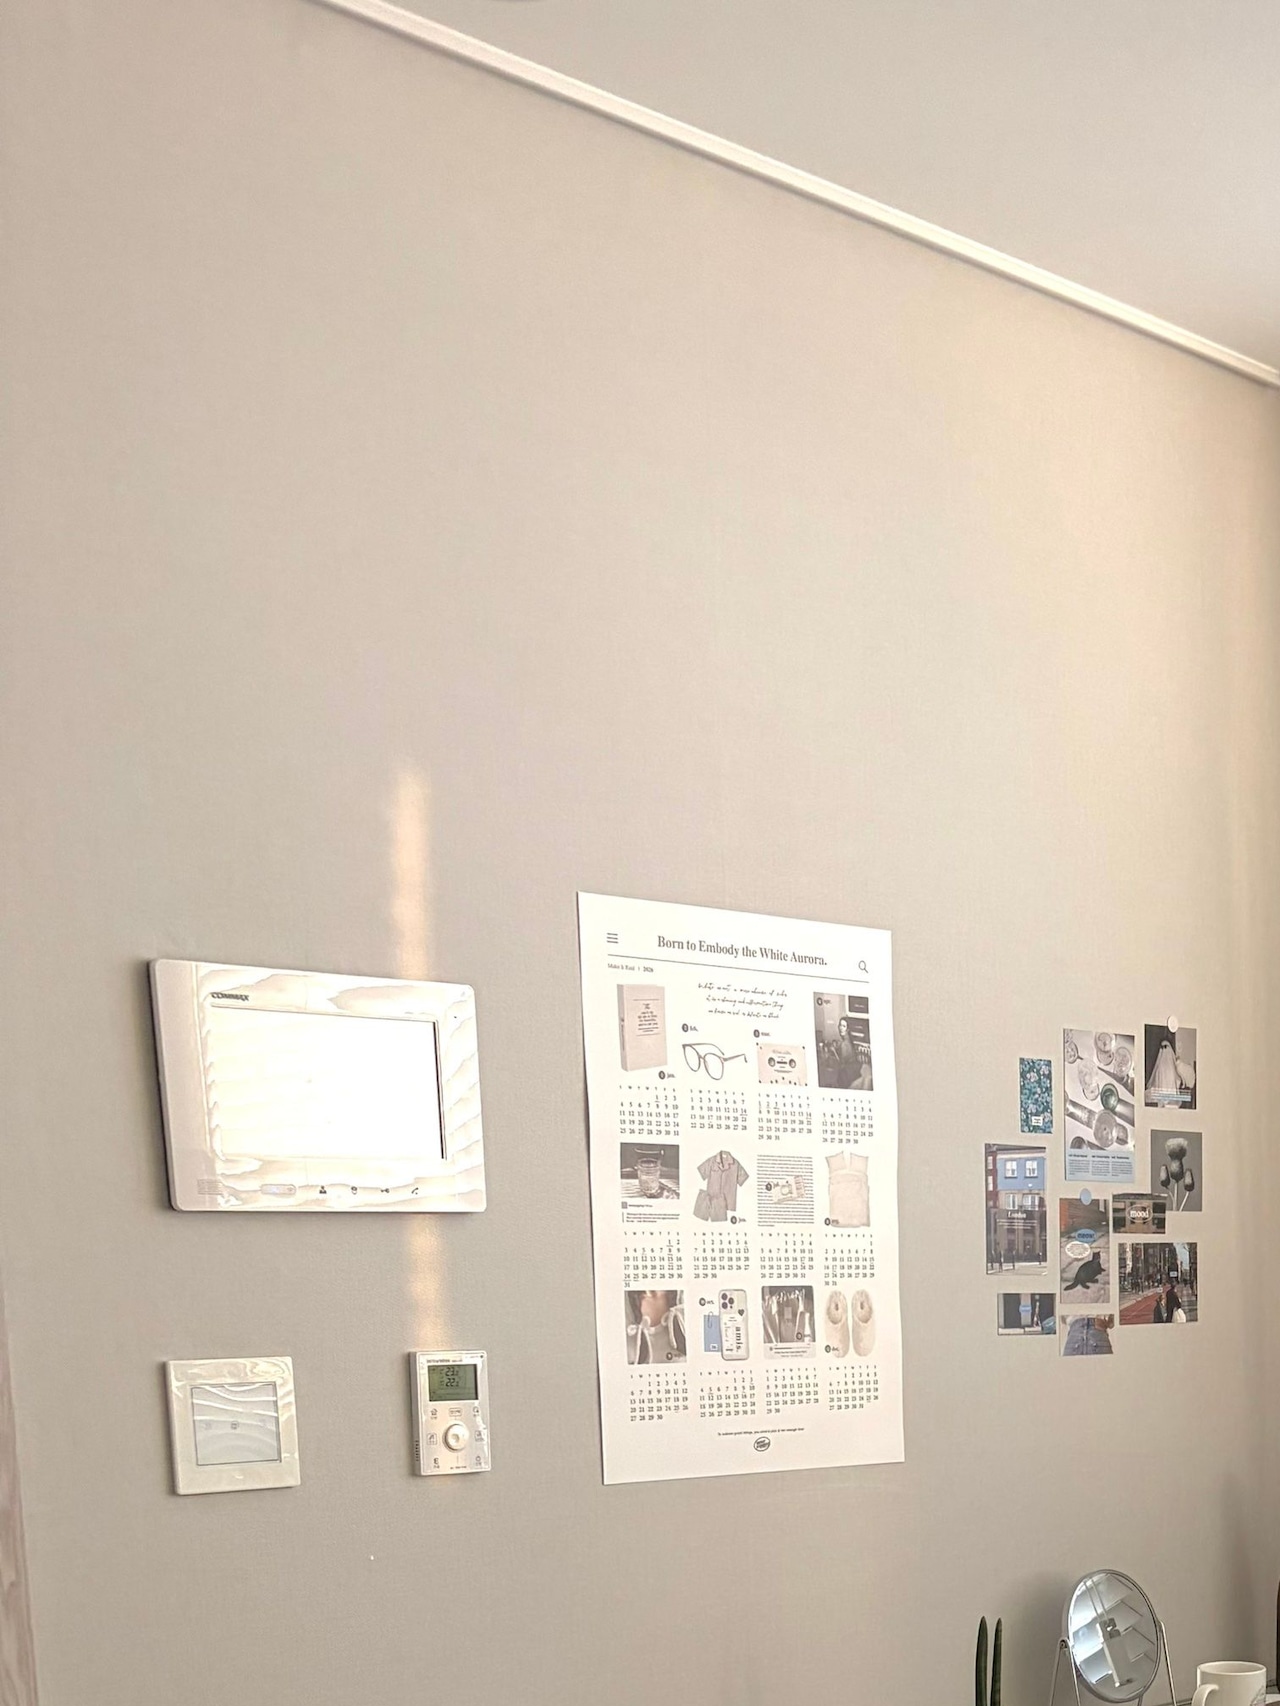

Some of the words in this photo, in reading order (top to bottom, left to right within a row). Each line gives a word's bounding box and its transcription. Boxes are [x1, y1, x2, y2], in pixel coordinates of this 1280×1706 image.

[658, 936, 684, 950] Born
[687, 940, 696, 950] to
[699, 940, 739, 958] Embody
[742, 946, 757, 957] the
[759, 948, 788, 961] White
[790, 952, 827, 965] Aurora.
[1130, 1210, 1149, 1218] mood
